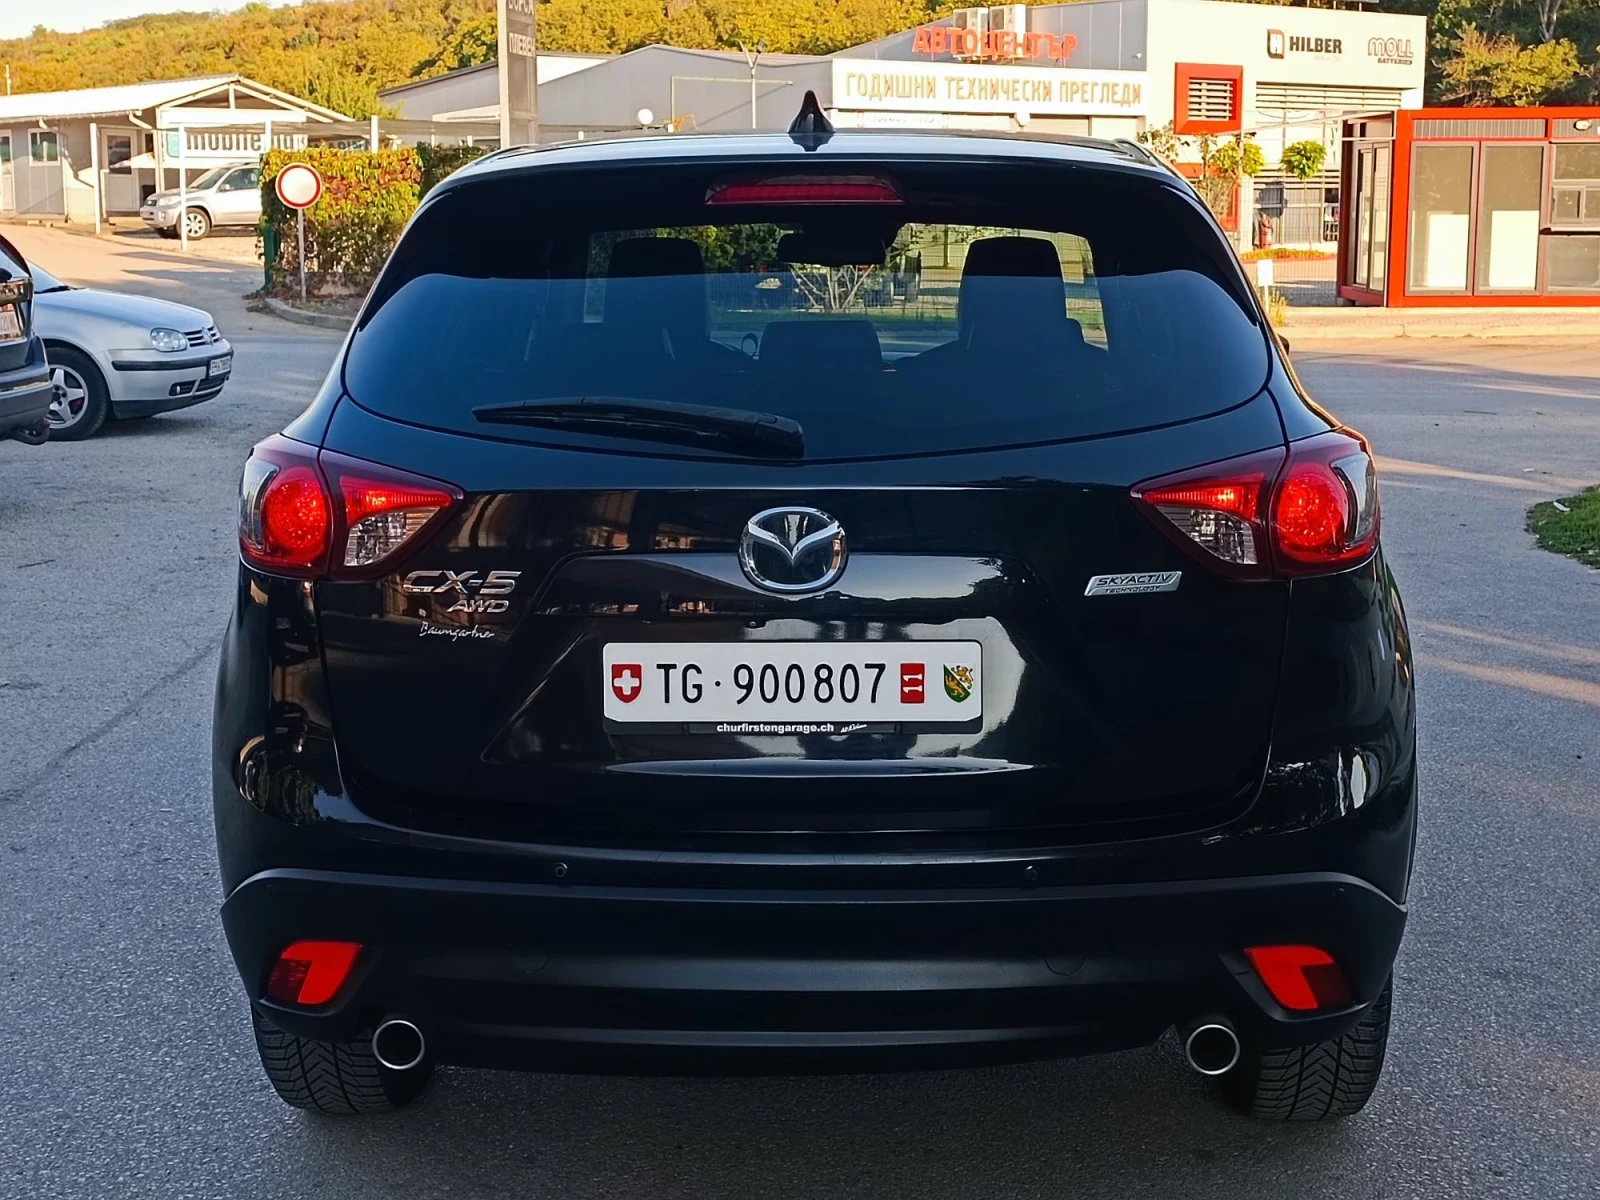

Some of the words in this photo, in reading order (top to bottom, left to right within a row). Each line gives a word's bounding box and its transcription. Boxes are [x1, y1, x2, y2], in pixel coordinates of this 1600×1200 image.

[508, 32, 535, 59] ПЛЕВЕН
[911, 25, 1077, 60] АВТОЦЕНТЪР
[1289, 36, 1342, 54] HILBER
[1377, 57, 1413, 65] BATTERIES
[845, 72, 937, 101] ГОДИШНИ
[944, 76, 1052, 102] ТЕХНИЧЕСКИ
[1059, 80, 1142, 107] ПРЕГЛЕДИ
[403, 570, 522, 595] CX-5
[1096, 573, 1173, 586] SKYACTIV
[1105, 585, 1161, 594] TECHNOLOGY
[446, 599, 510, 613] AWD
[419, 620, 495, 641] Baumgartner
[716, 722, 835, 734] churfirstengarage.ch
